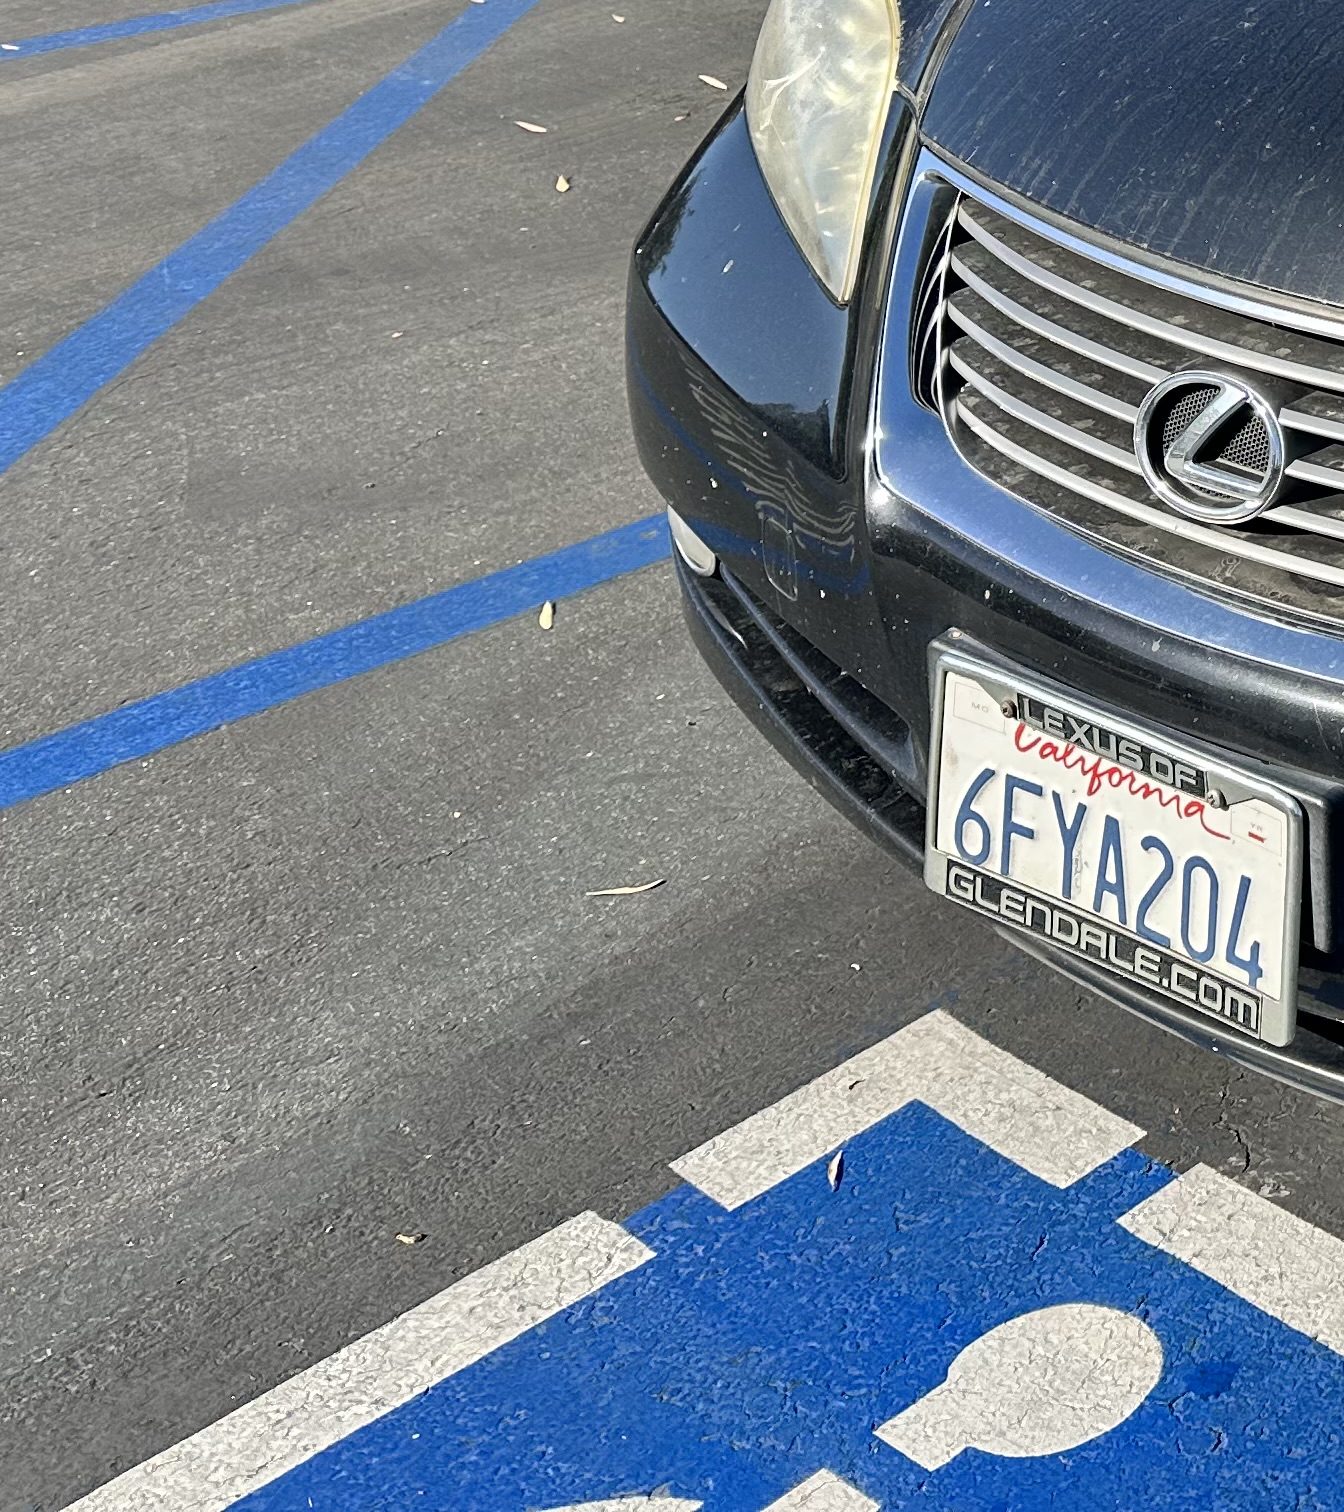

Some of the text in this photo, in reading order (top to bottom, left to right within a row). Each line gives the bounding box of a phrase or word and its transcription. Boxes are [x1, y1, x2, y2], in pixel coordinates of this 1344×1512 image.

[971, 701, 989, 713] MO
[1023, 697, 1198, 789] LEXUS OF
[954, 768, 1264, 988] 6FYA204
